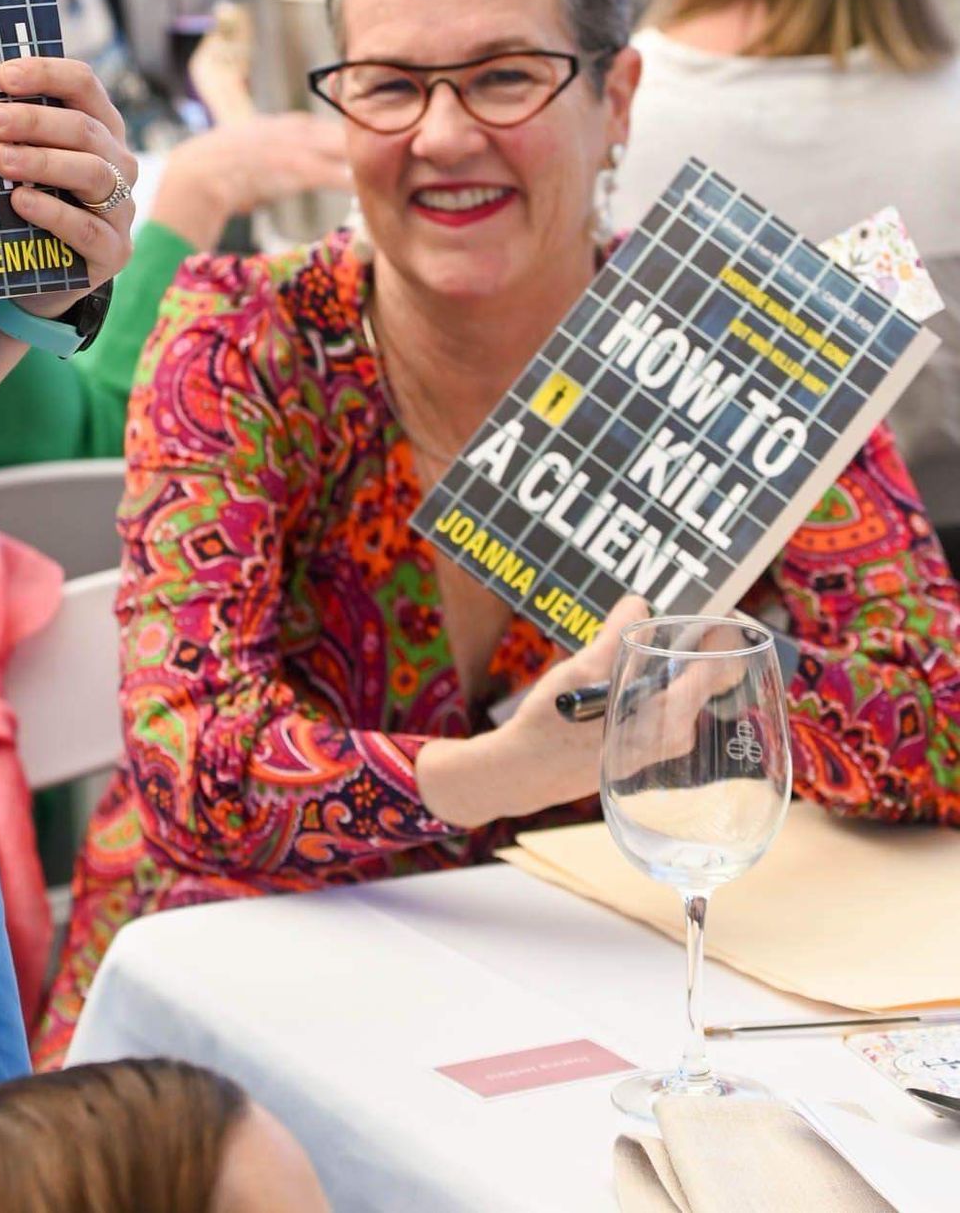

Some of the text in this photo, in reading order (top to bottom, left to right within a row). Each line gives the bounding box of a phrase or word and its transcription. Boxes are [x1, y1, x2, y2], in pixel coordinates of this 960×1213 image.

[598, 299, 742, 424] HOW
[726, 388, 808, 478] TO
[466, 418, 709, 613] A CLIENT
[627, 427, 748, 551] KILL
[435, 509, 605, 645] JOANNA JENK
